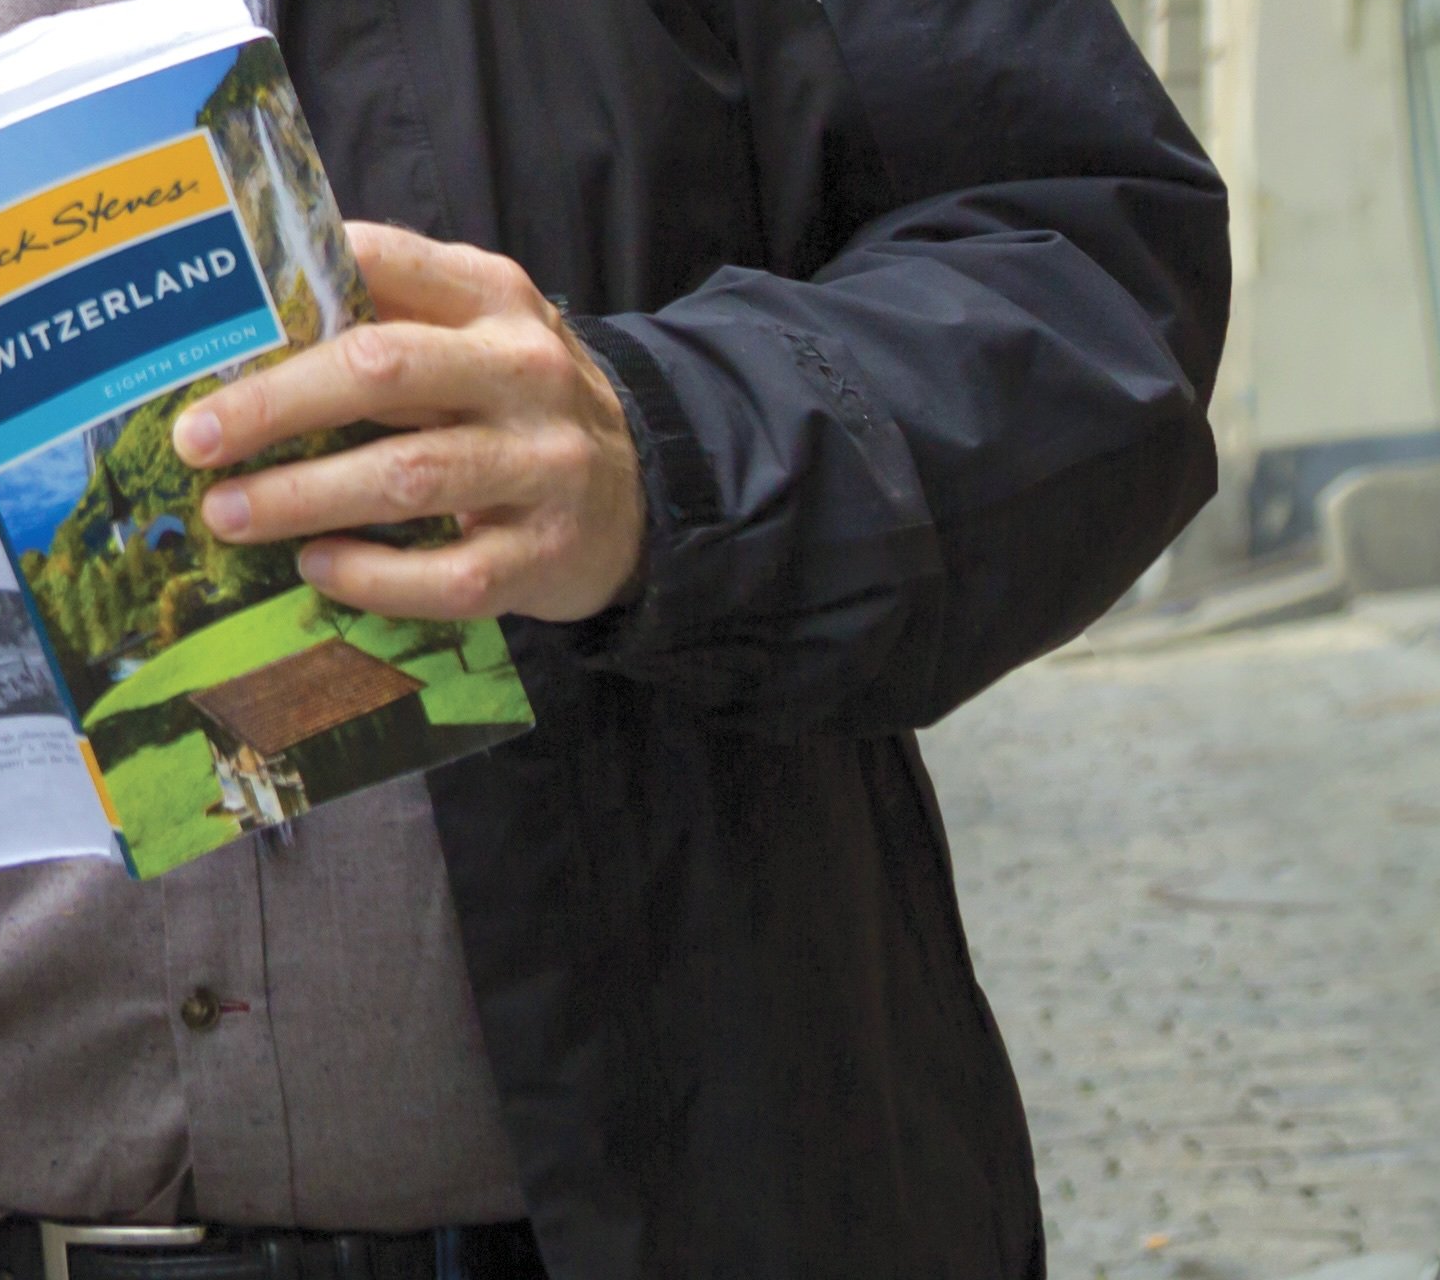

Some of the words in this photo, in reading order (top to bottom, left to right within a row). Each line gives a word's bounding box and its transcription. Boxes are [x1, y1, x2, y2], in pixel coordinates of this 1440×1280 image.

[53, 179, 199, 247] Steves
[104, 359, 173, 399] EIGHTH
[178, 325, 257, 366] EDITION
